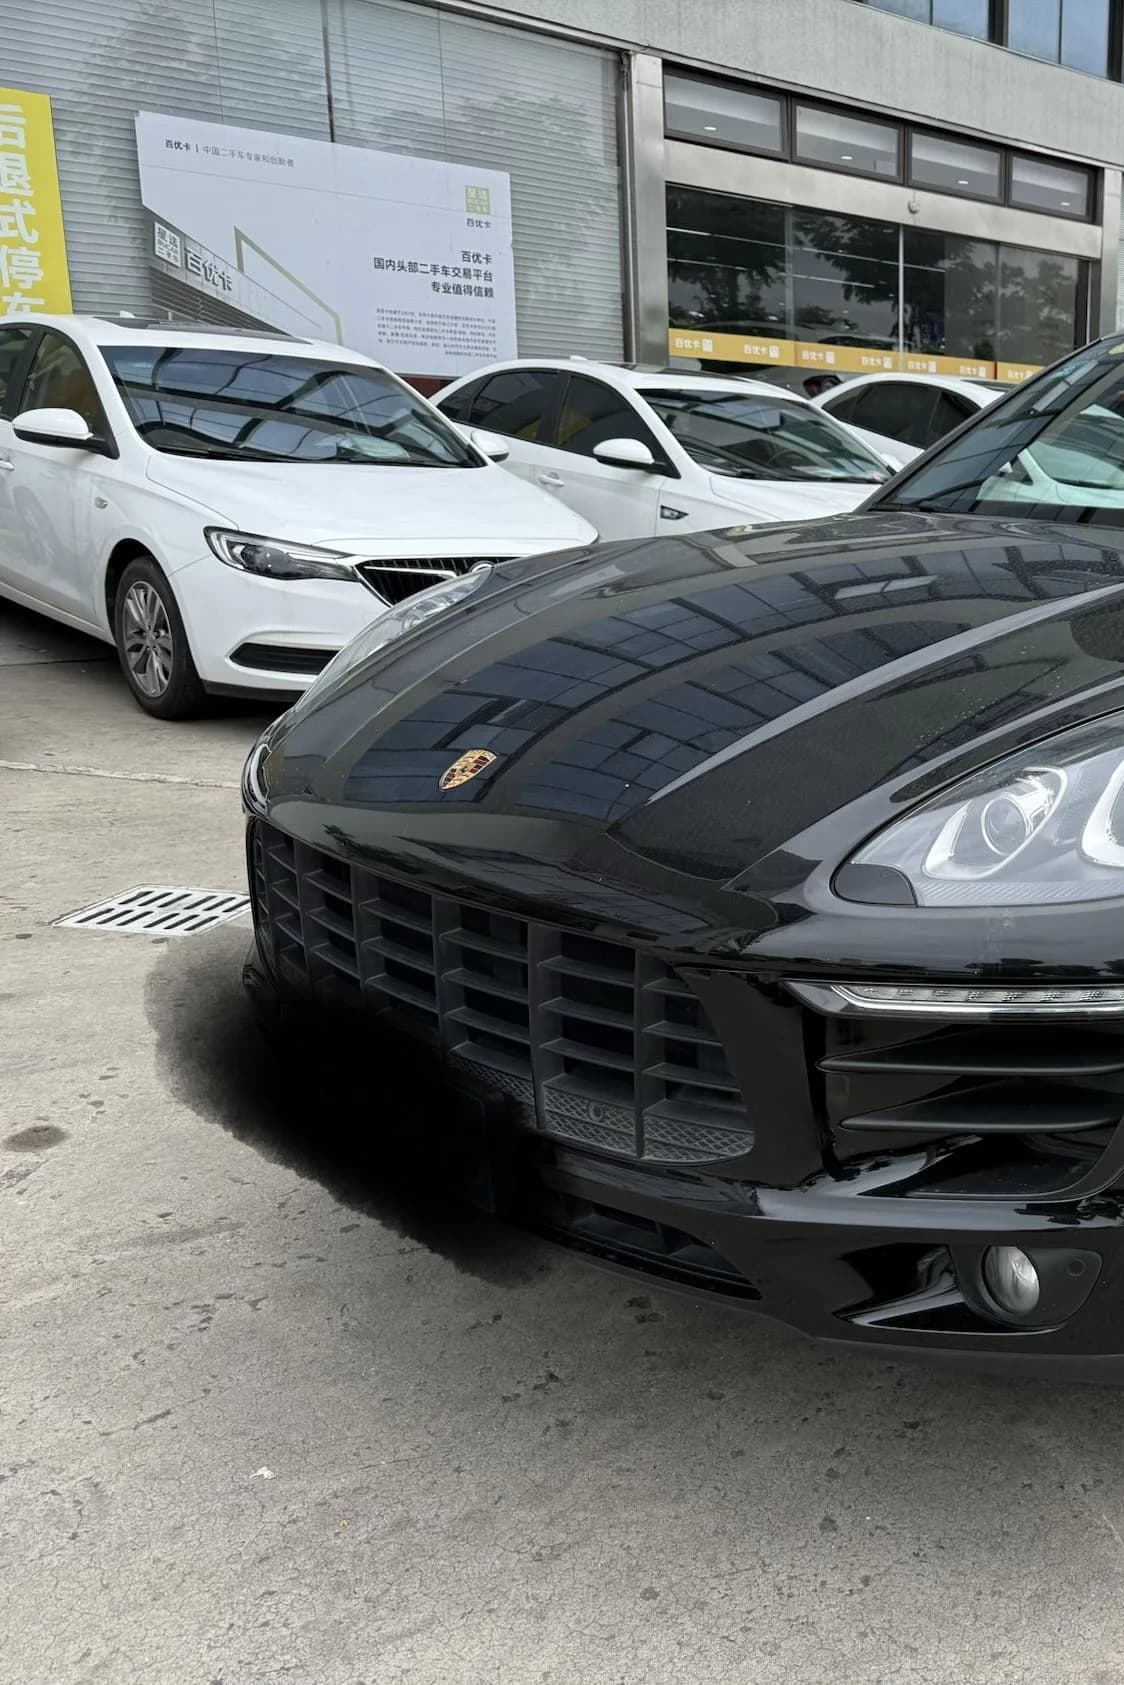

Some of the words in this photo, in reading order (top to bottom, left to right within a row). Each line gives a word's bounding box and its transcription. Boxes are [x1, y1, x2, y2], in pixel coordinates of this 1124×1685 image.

[461, 250, 492, 265] 百优卡
[184, 247, 232, 291] 百优卡
[373, 257, 493, 282] 国内头部二手车交易平台
[431, 281, 494, 298] 专业值得信赖
